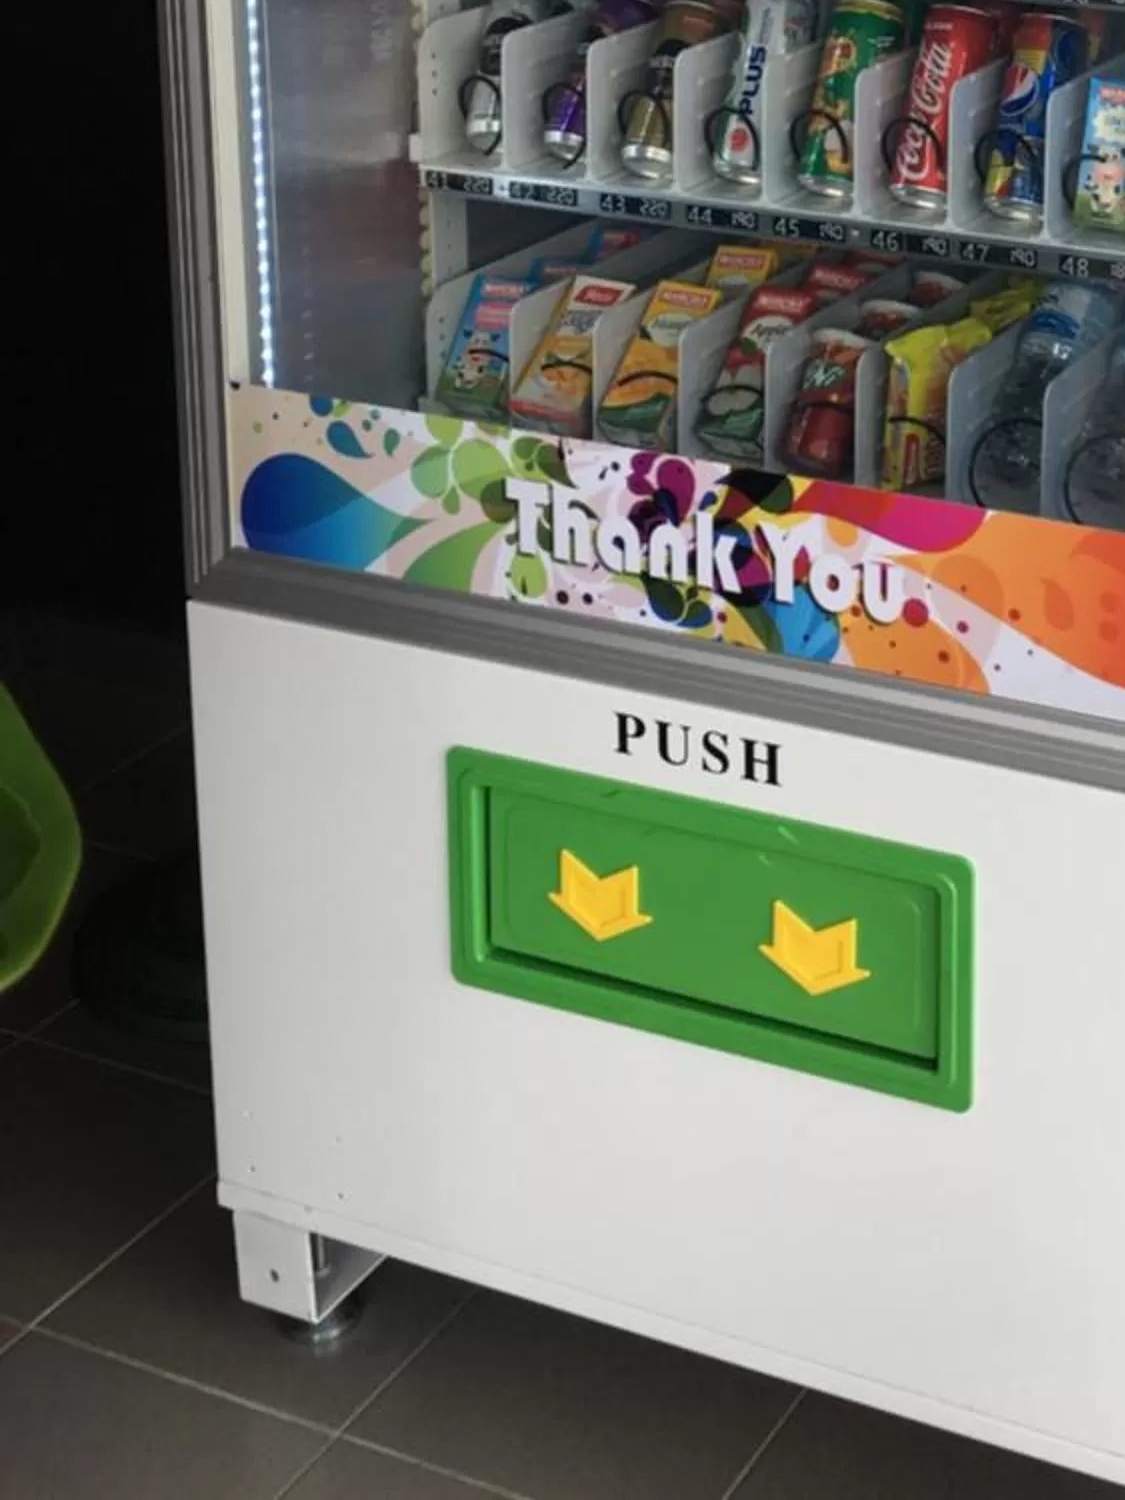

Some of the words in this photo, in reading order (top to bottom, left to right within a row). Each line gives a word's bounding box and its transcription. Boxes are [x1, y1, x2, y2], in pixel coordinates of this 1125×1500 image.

[739, 45, 767, 116] PLUS
[774, 218, 801, 237] 45
[872, 232, 898, 252] 46
[962, 244, 989, 263] 47
[1060, 257, 1090, 278] 48
[505, 476, 743, 595] Thank
[757, 520, 907, 627] You
[612, 711, 784, 787] PUSH
